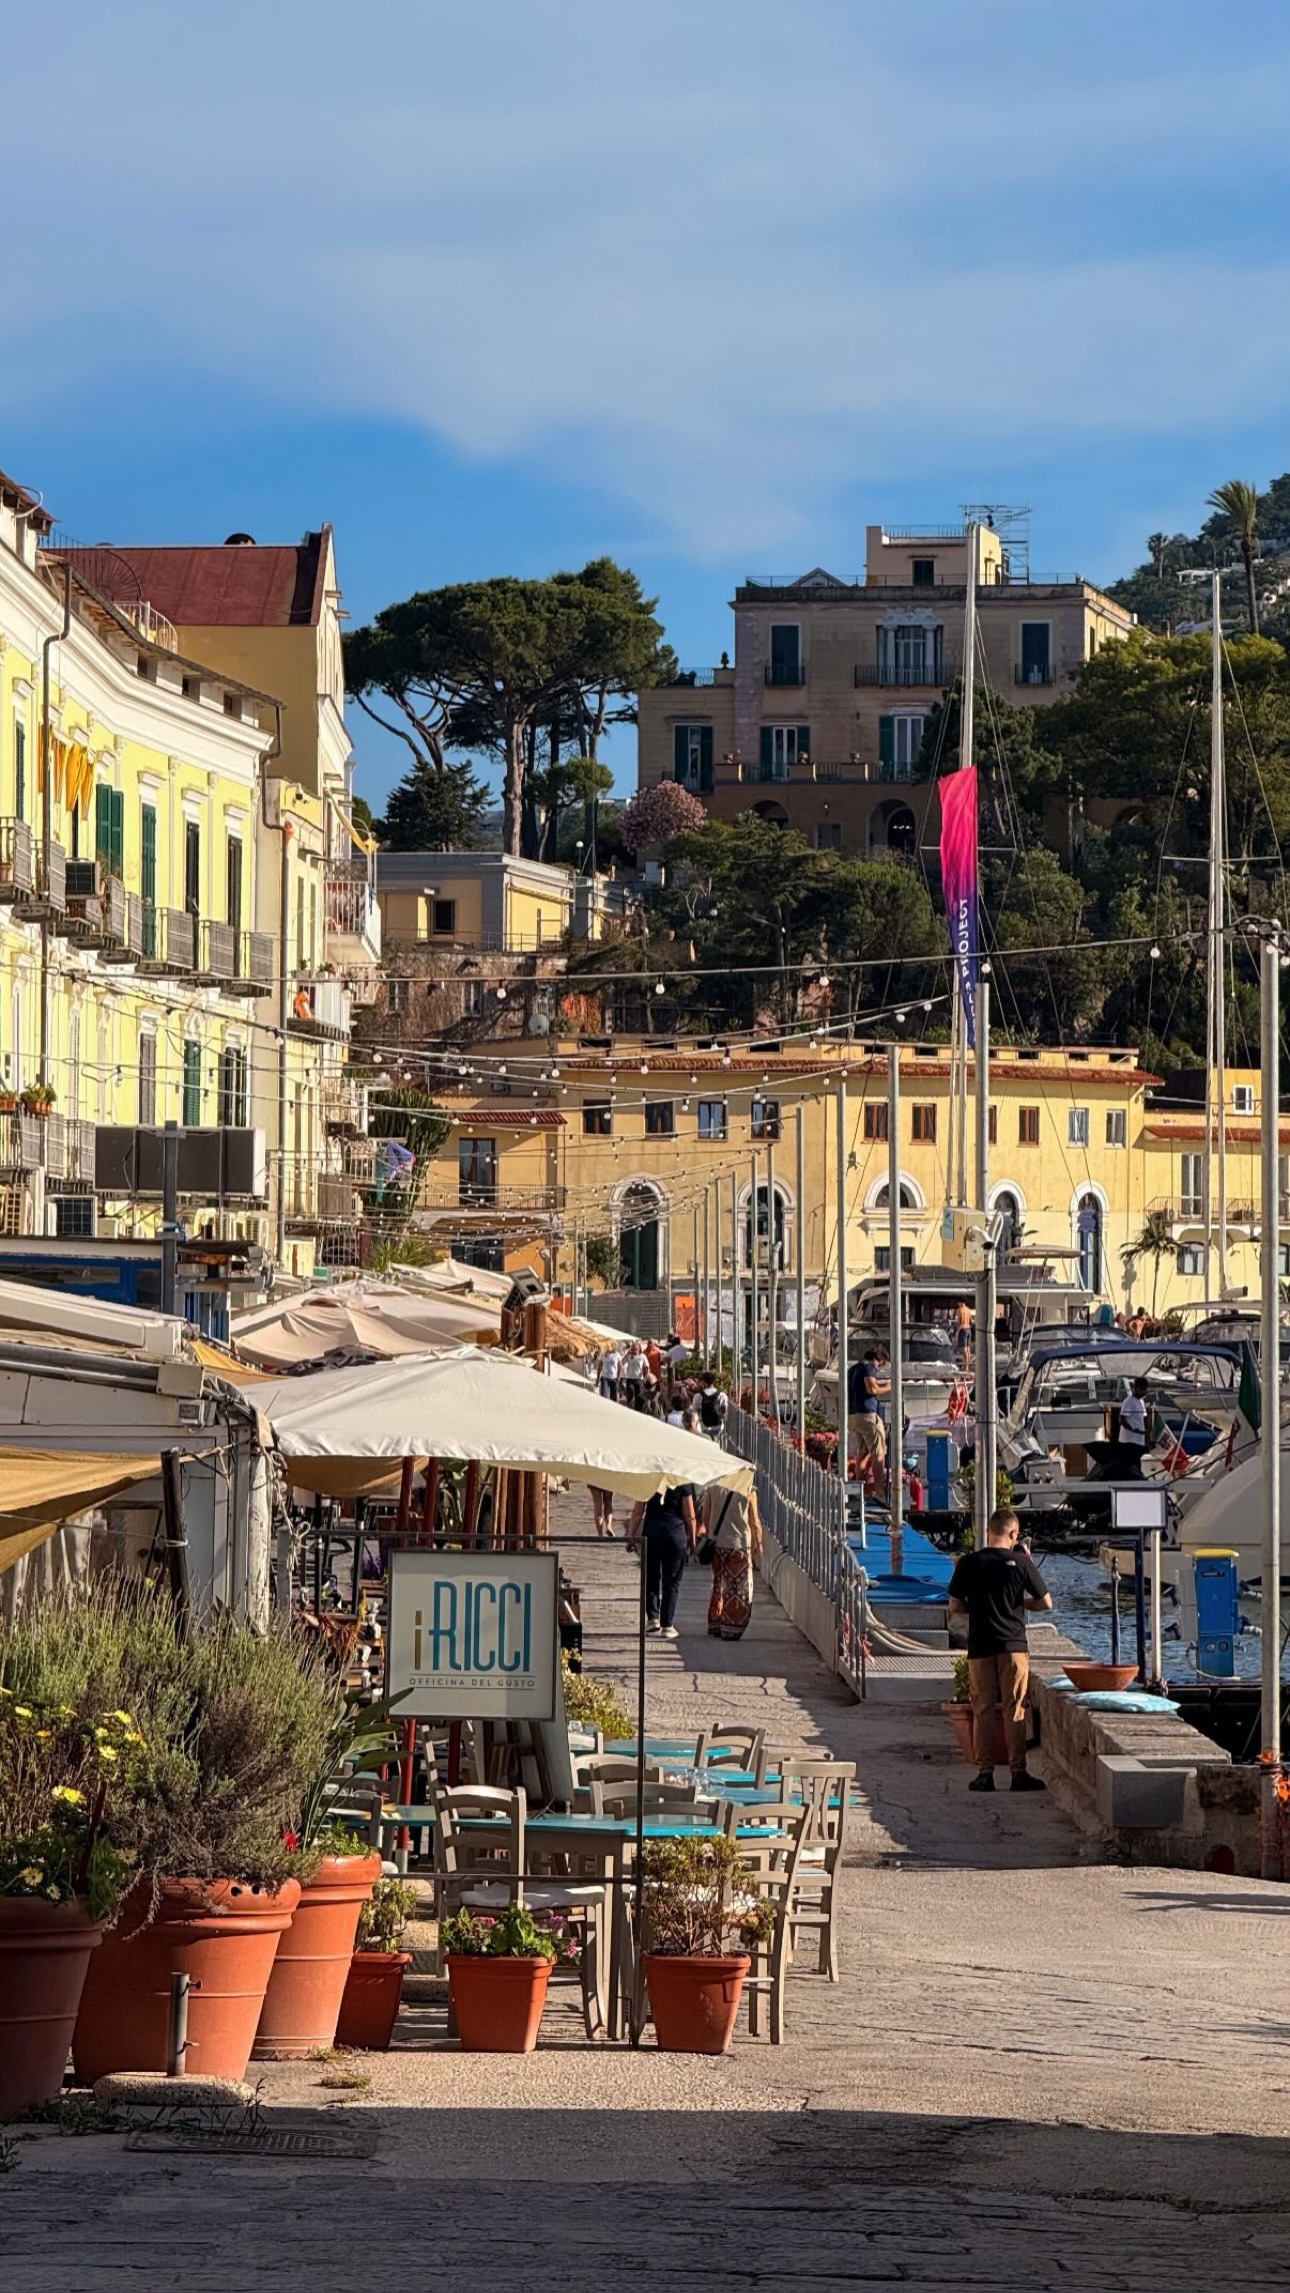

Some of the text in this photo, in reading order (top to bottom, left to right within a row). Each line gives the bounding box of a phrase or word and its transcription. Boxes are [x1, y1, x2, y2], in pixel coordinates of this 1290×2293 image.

[958, 898, 969, 977] PROJECT
[428, 1581, 532, 1672] RICCI
[409, 1678, 465, 1686] OFFICINA
